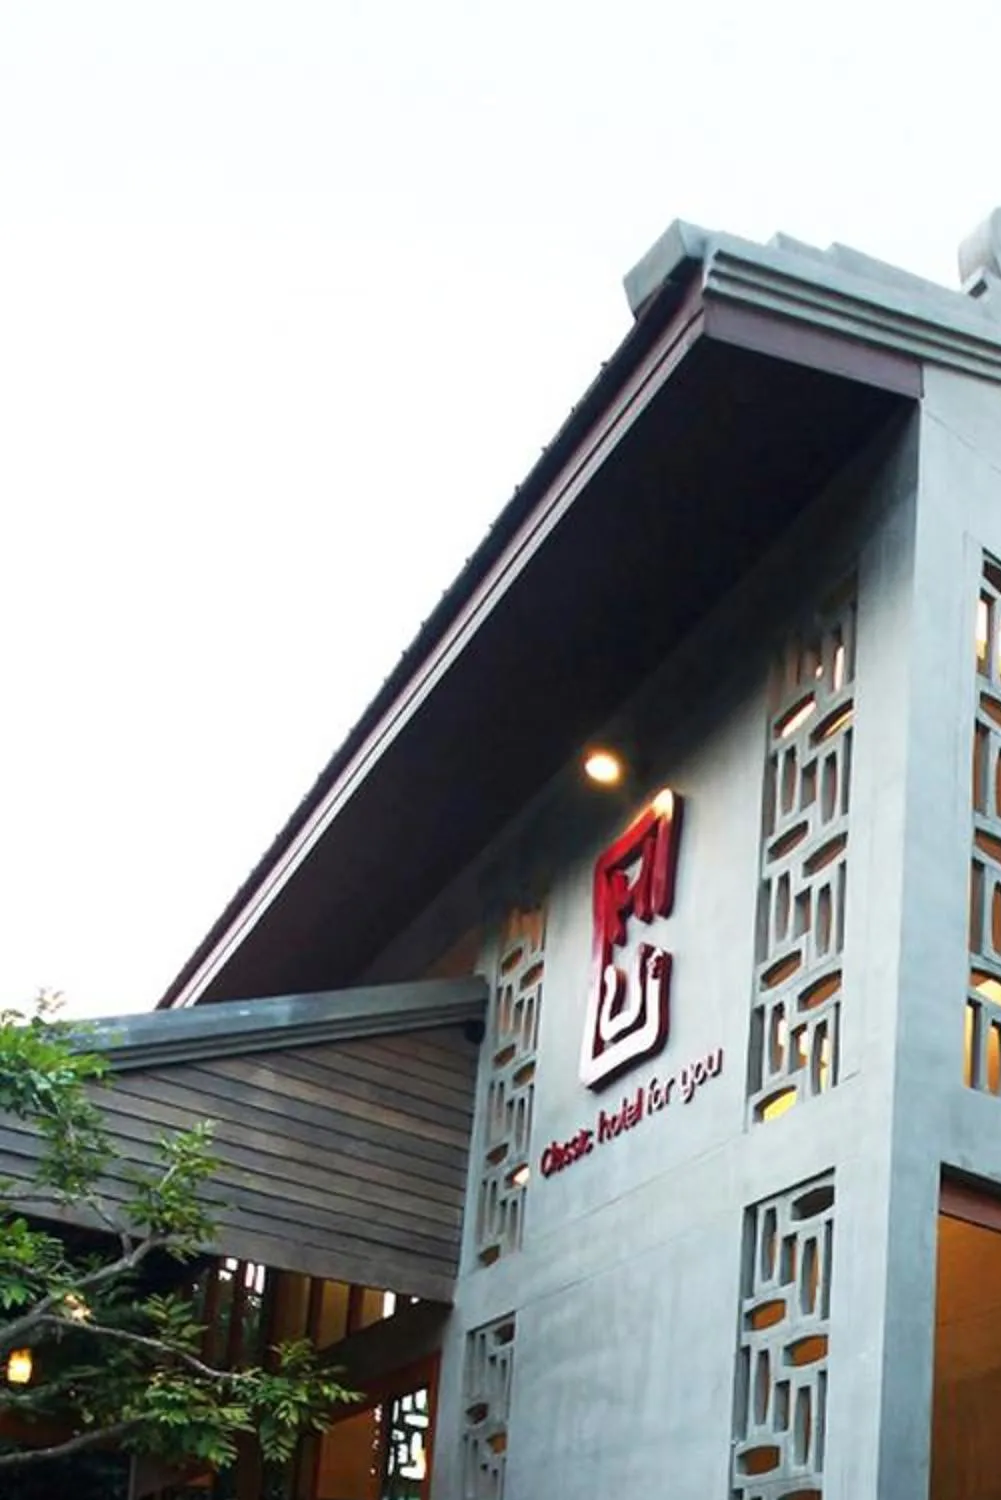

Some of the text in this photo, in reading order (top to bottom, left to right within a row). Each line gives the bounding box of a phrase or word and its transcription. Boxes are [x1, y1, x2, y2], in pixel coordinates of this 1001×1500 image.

[597, 1086, 644, 1143] hotel
[646, 1076, 676, 1115] for
[679, 1047, 724, 1104] you
